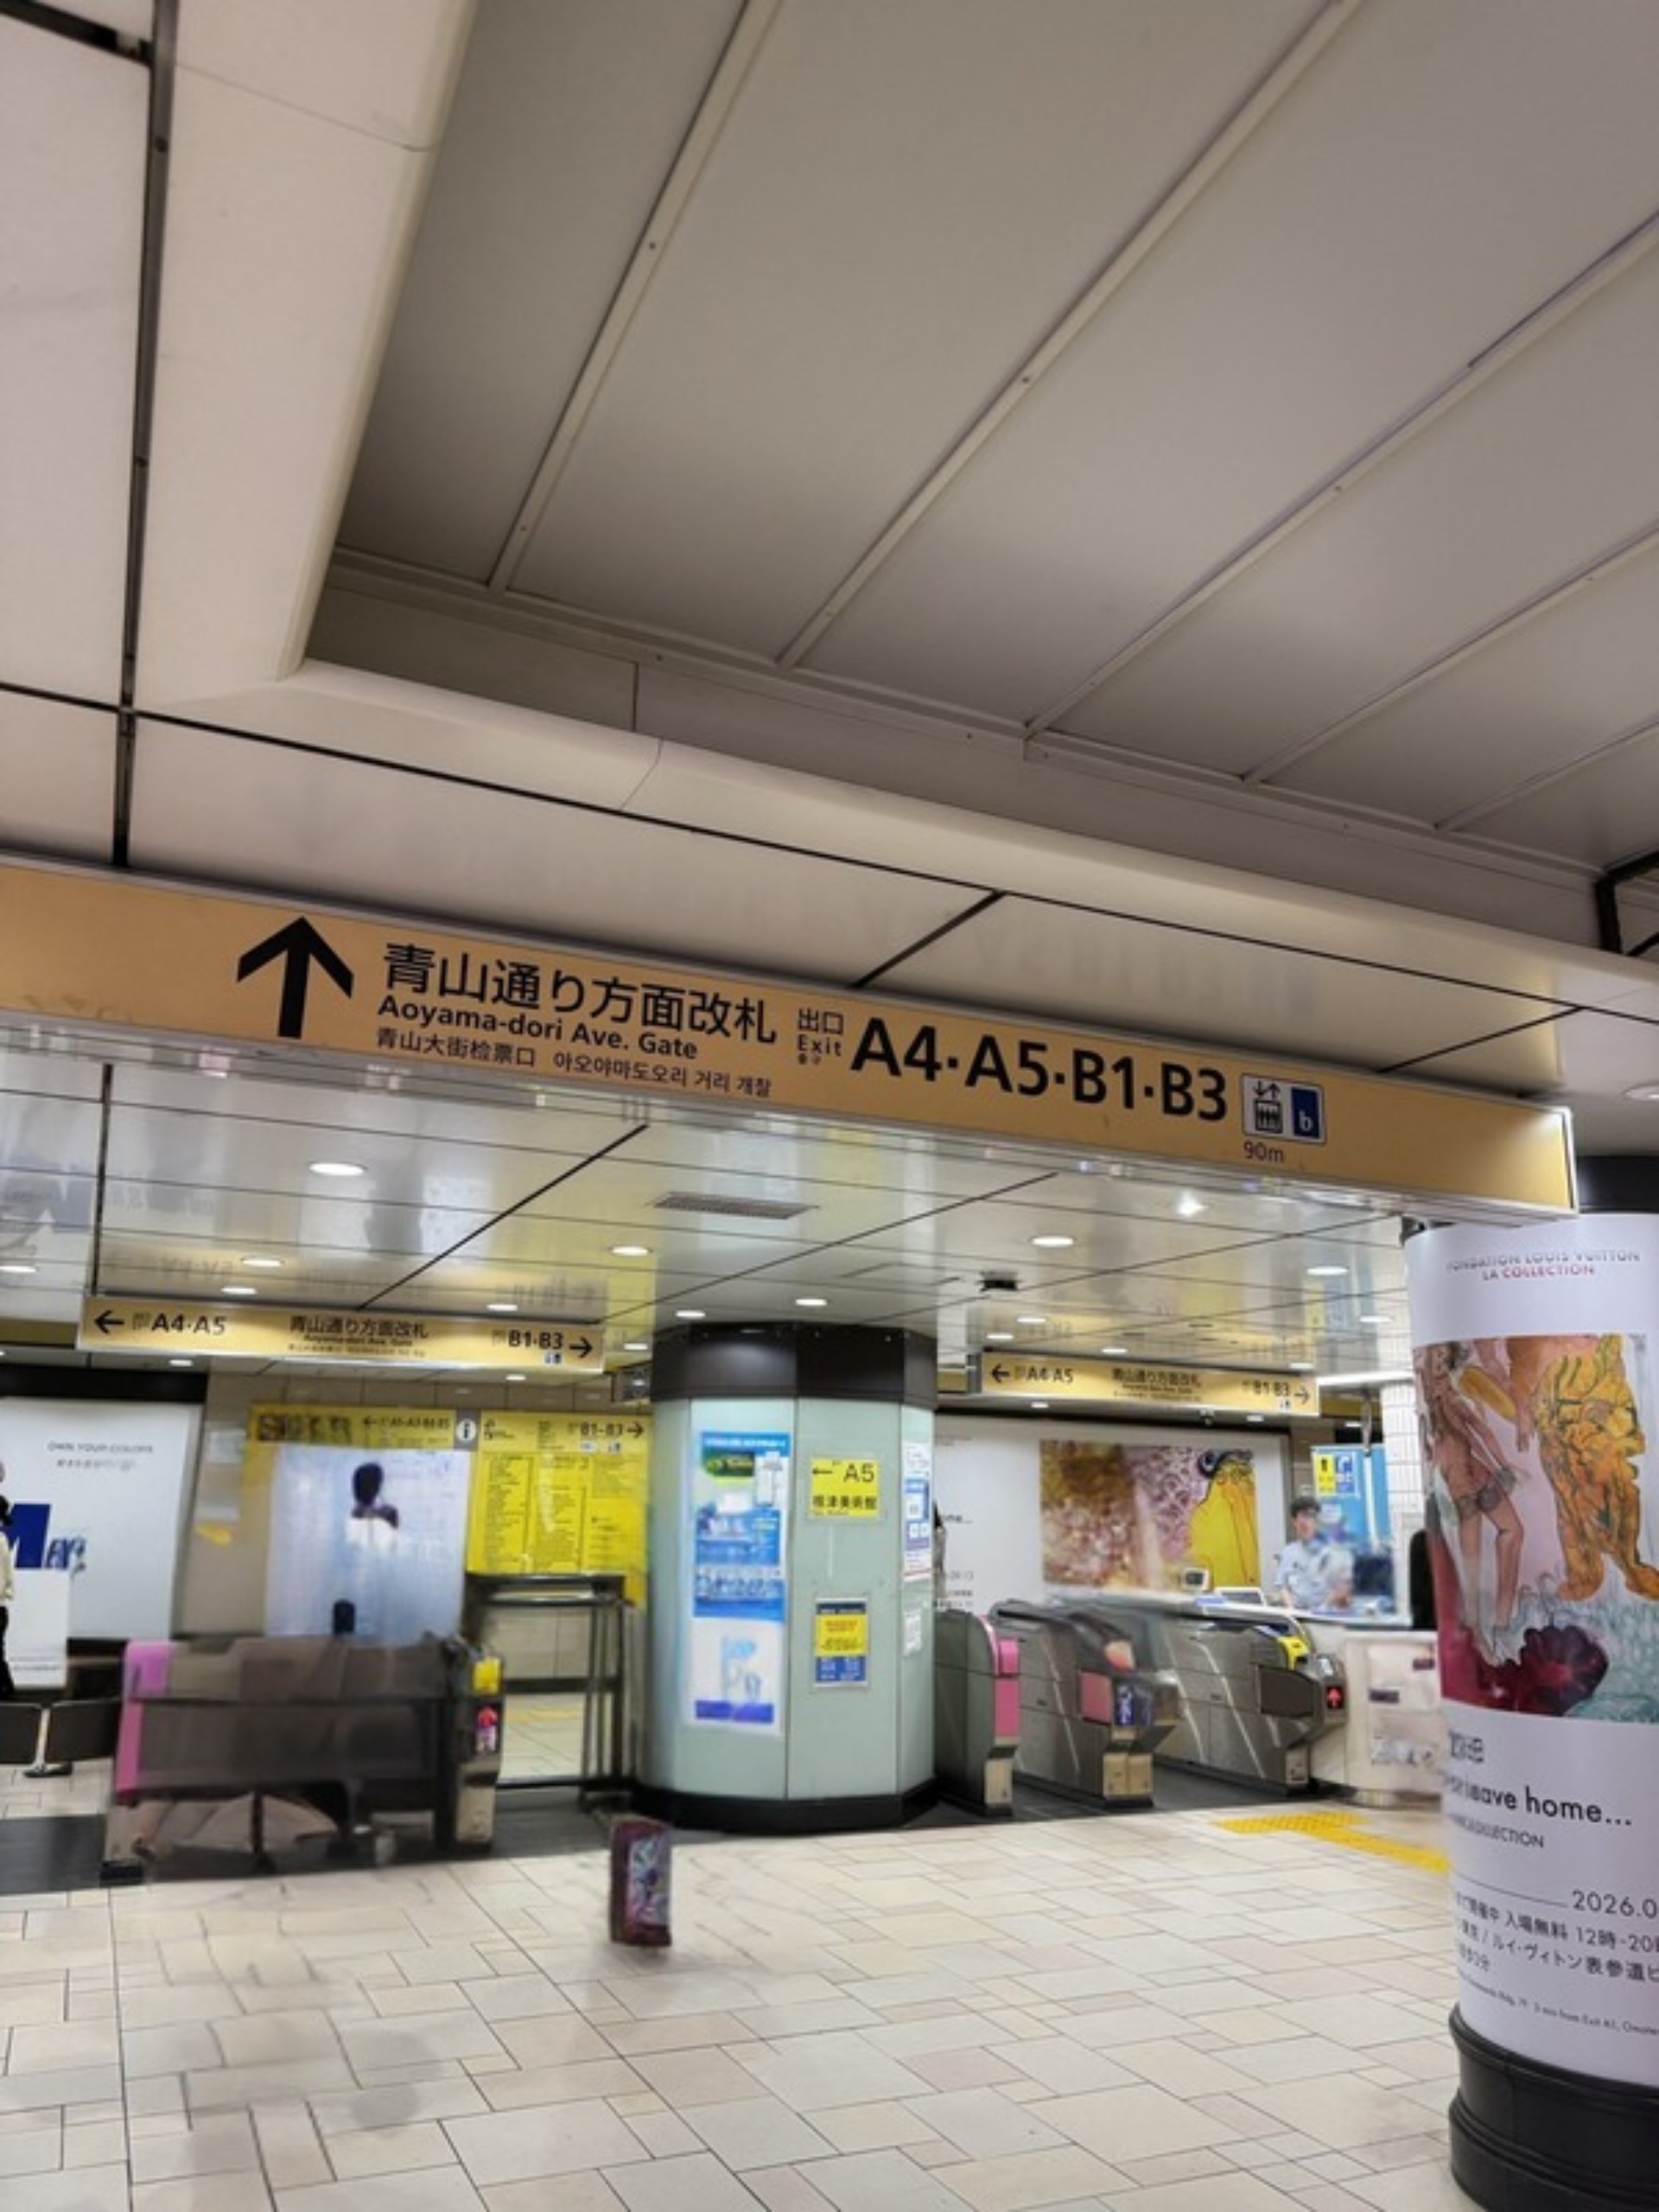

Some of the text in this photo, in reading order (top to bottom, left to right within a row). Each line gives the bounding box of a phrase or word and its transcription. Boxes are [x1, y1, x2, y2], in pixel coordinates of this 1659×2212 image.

[384, 942, 777, 1044] 青山通り方面改札
[378, 995, 698, 1060] Aoyama-dori Ave. Gate
[798, 1007, 844, 1035] 出口
[378, 1027, 536, 1067] 青山大街检票口
[798, 1034, 842, 1057] Exit
[554, 1052, 772, 1098] 아오야마도오리 거리 개찰
[1243, 1139, 1285, 1163] 90m
[1502, 1263, 1596, 1279] COLLECTION
[843, 1462, 874, 1483] A5
[1525, 1785, 1632, 1827] home...
[1505, 1910, 1569, 1940] 入場無料
[1576, 1926, 1659, 1955] 12時-20
